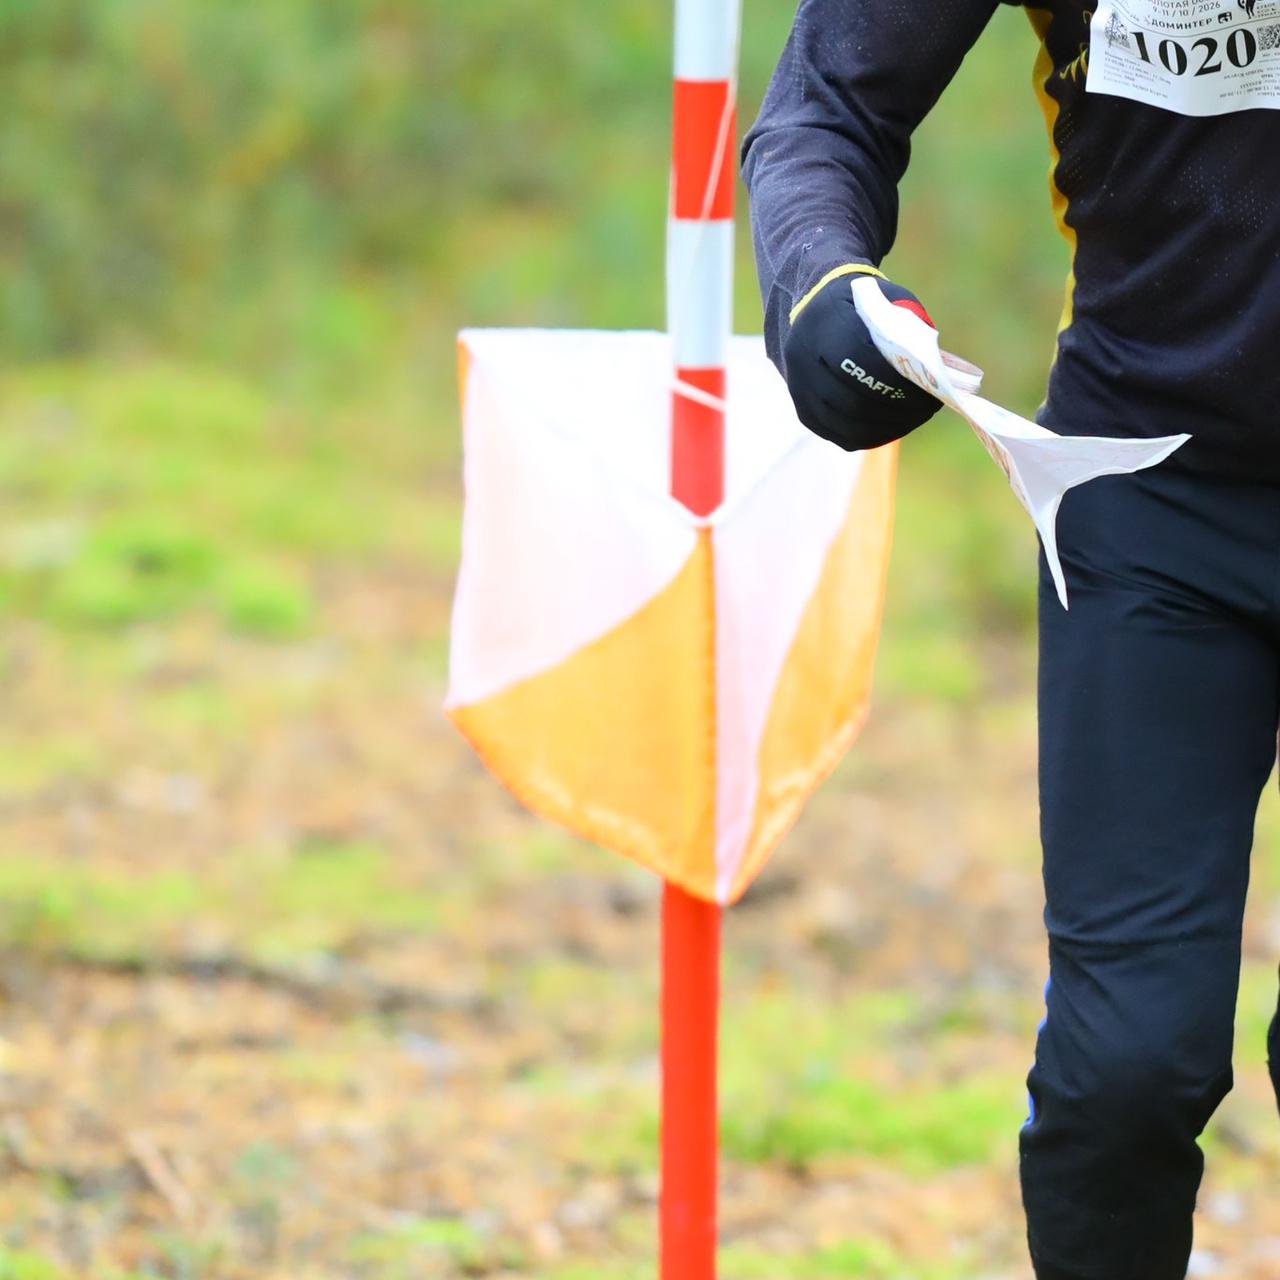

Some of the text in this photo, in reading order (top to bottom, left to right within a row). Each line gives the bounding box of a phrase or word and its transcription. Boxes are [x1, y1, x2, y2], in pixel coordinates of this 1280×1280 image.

[1179, 9, 1189, 17] 10
[1199, 1, 1221, 13] 2026
[1151, 17, 1213, 30] ДОМИНТЕР
[1129, 28, 1257, 77] 1020
[840, 358, 895, 395] CRAFT
